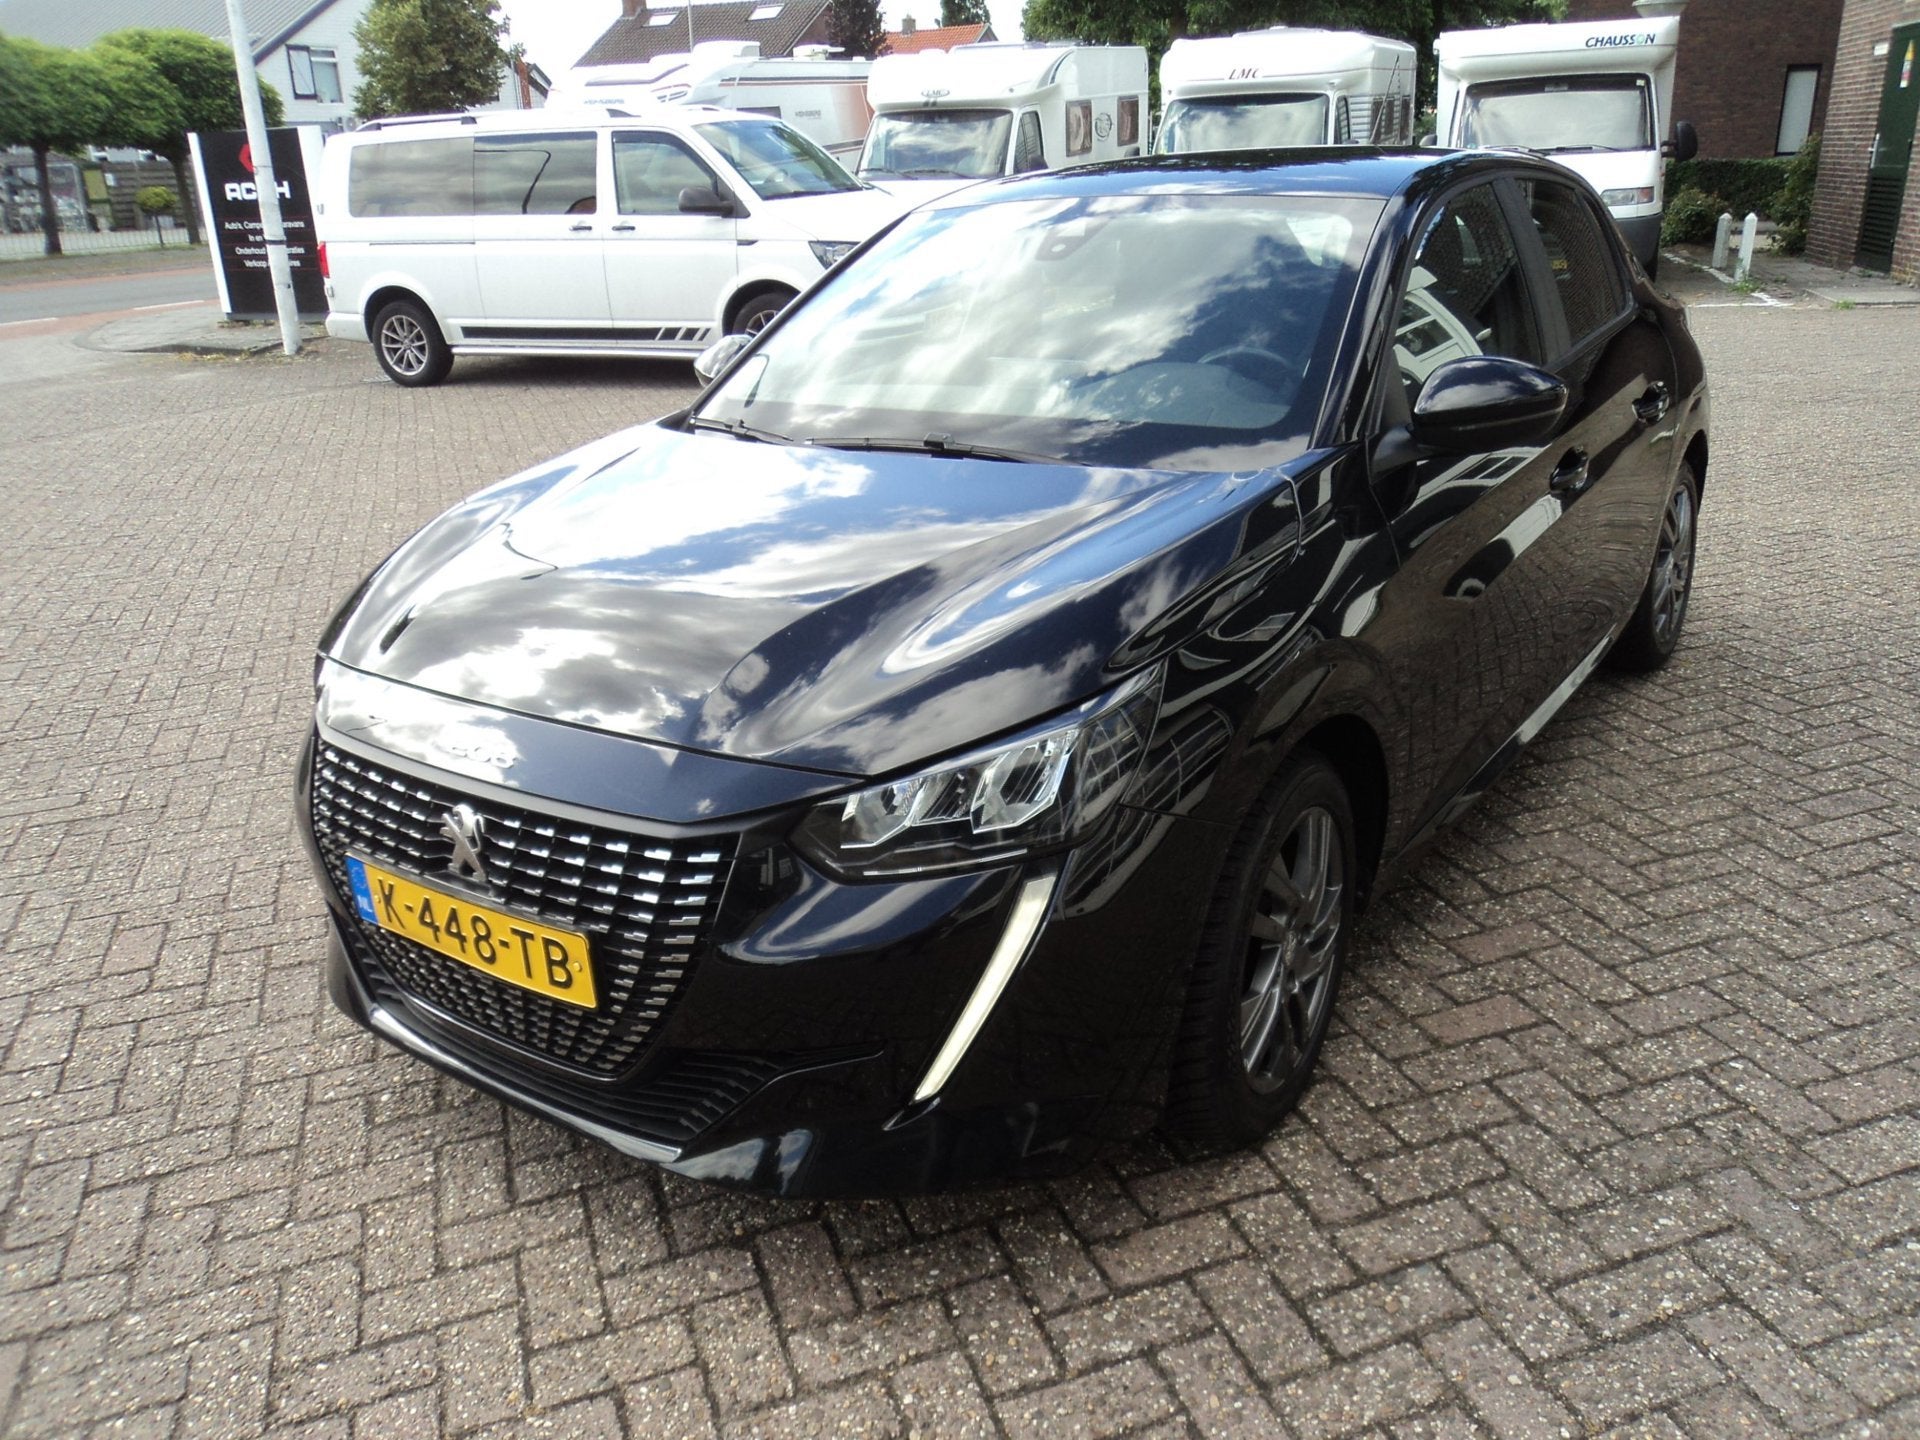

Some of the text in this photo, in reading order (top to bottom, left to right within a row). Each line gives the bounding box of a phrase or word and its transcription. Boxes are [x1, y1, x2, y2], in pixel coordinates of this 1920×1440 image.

[1585, 34, 1656, 48] CHAUSSON
[1229, 68, 1259, 80] LMC
[225, 181, 291, 201] ACH
[282, 221, 304, 229] aravans
[244, 260, 267, 268] Verkoop
[378, 878, 574, 990] K-448-TB
